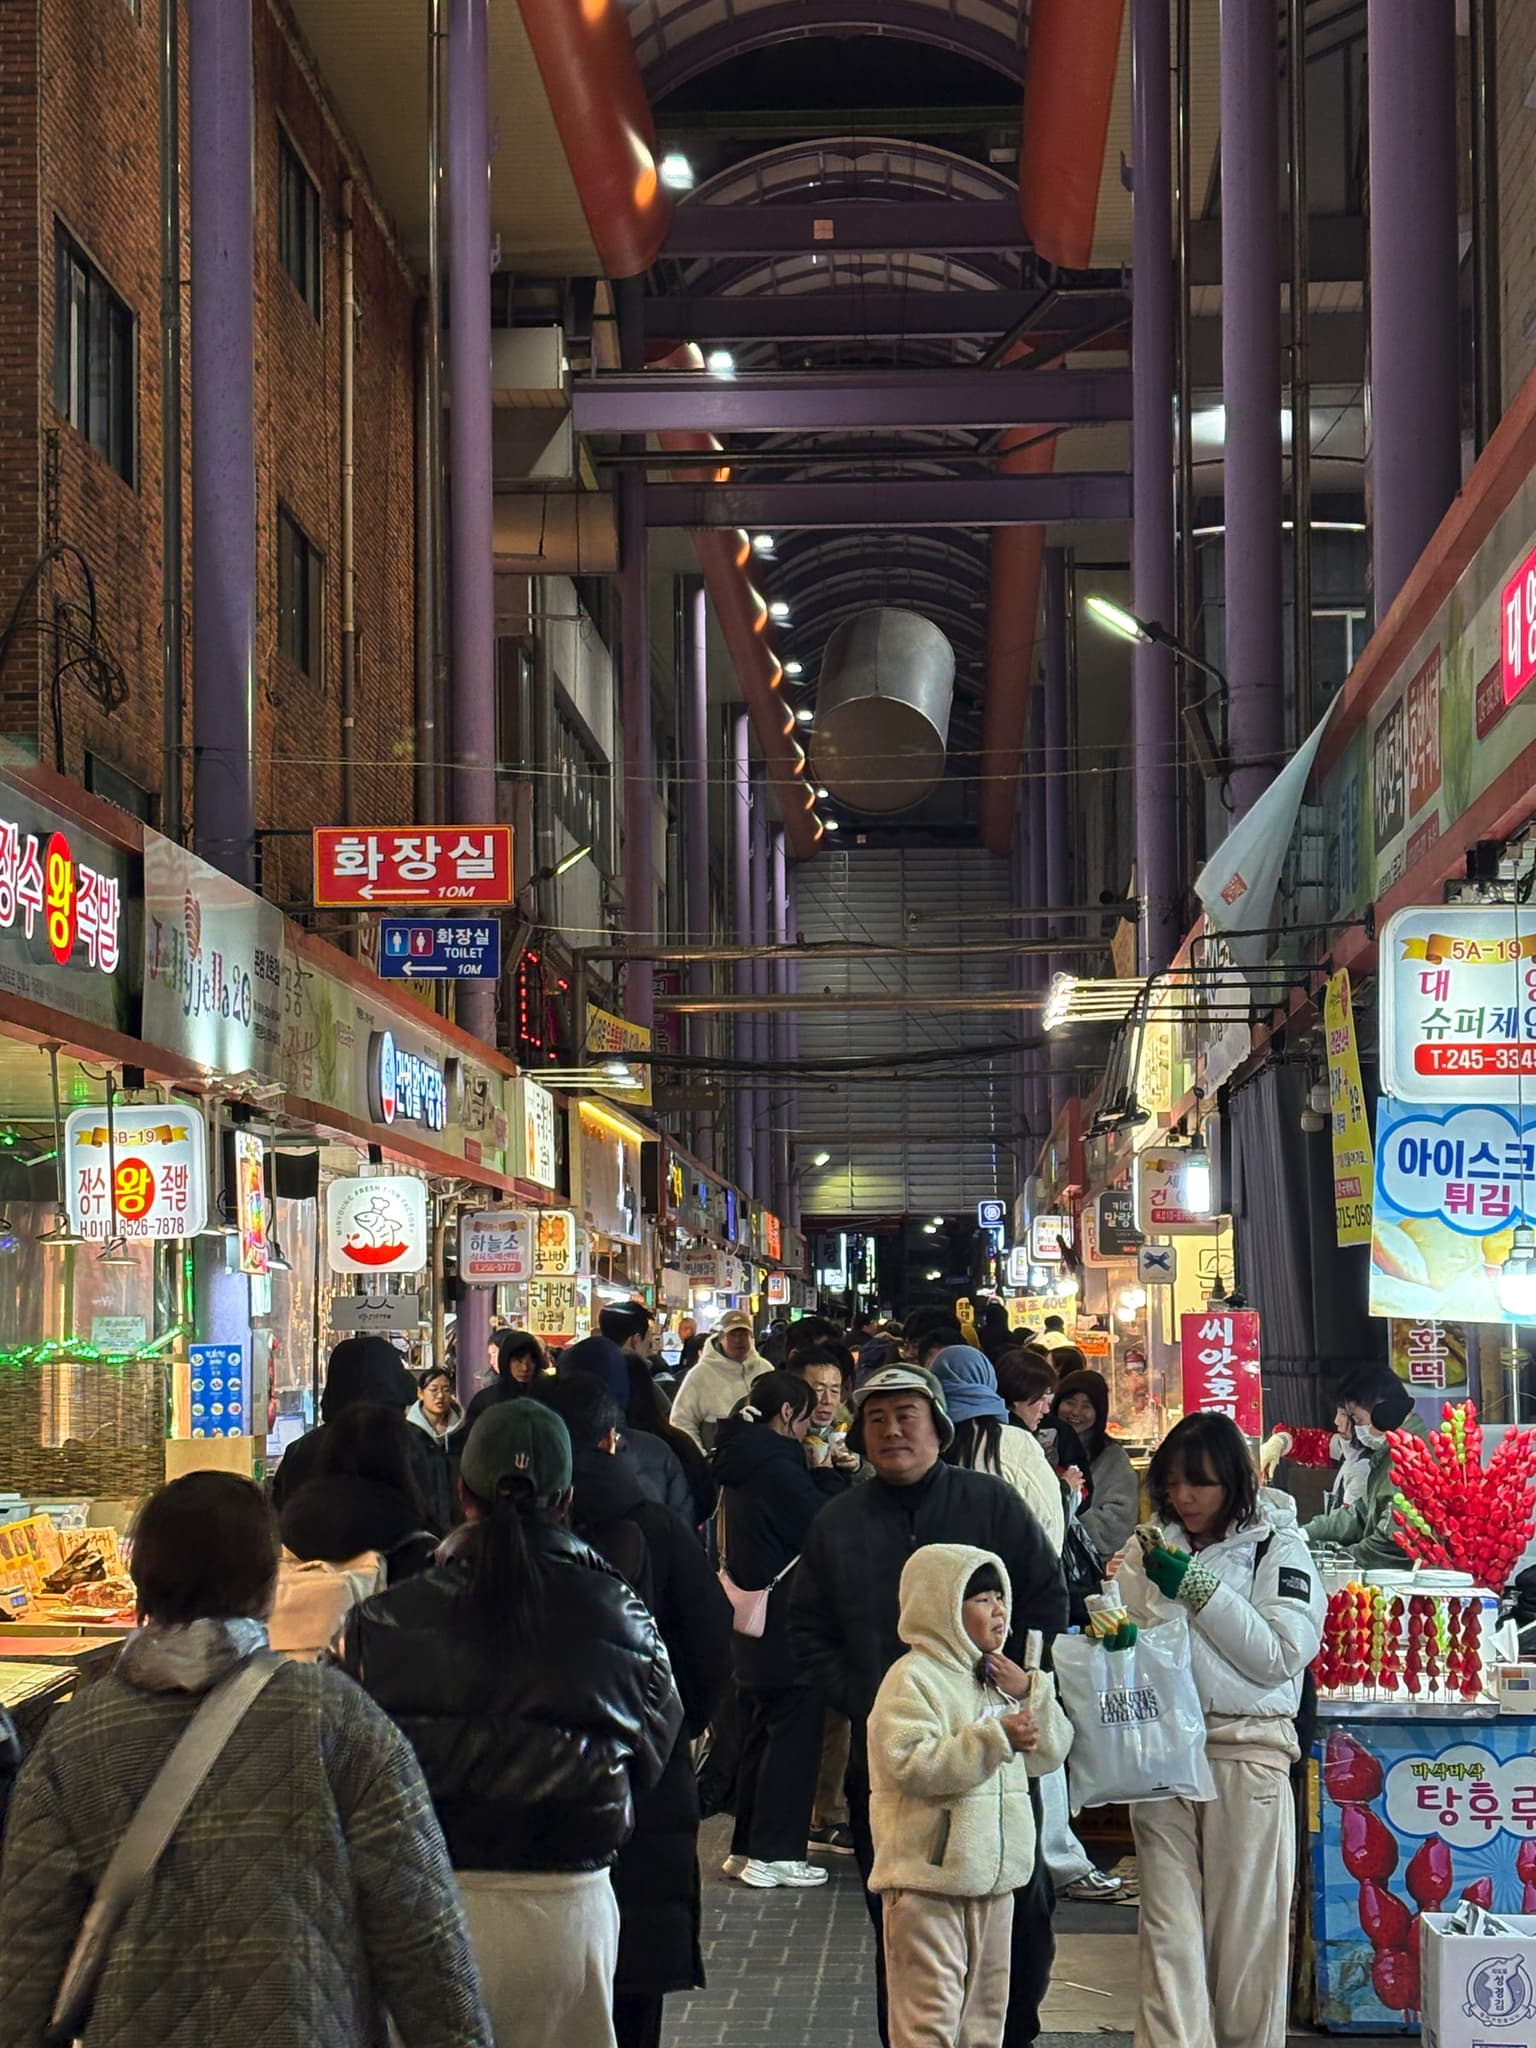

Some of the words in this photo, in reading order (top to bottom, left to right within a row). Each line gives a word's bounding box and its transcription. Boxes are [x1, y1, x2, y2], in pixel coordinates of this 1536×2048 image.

[334, 835, 495, 881] 화장실
[437, 886, 476, 898] 10M
[436, 928, 489, 945] 화장실
[444, 948, 484, 958] TOILET
[1452, 941, 1522, 960] 5A-19
[457, 964, 482, 975] 10M
[1444, 1183, 1511, 1217] 튀김
[80, 1217, 184, 1238] H.0108526-7878
[470, 1234, 519, 1252] 하늘소
[1408, 1319, 1449, 1389] 호떡
[1411, 1762, 1486, 1781] 바삭바삭
[1416, 1782, 1536, 1830] 탕후루
